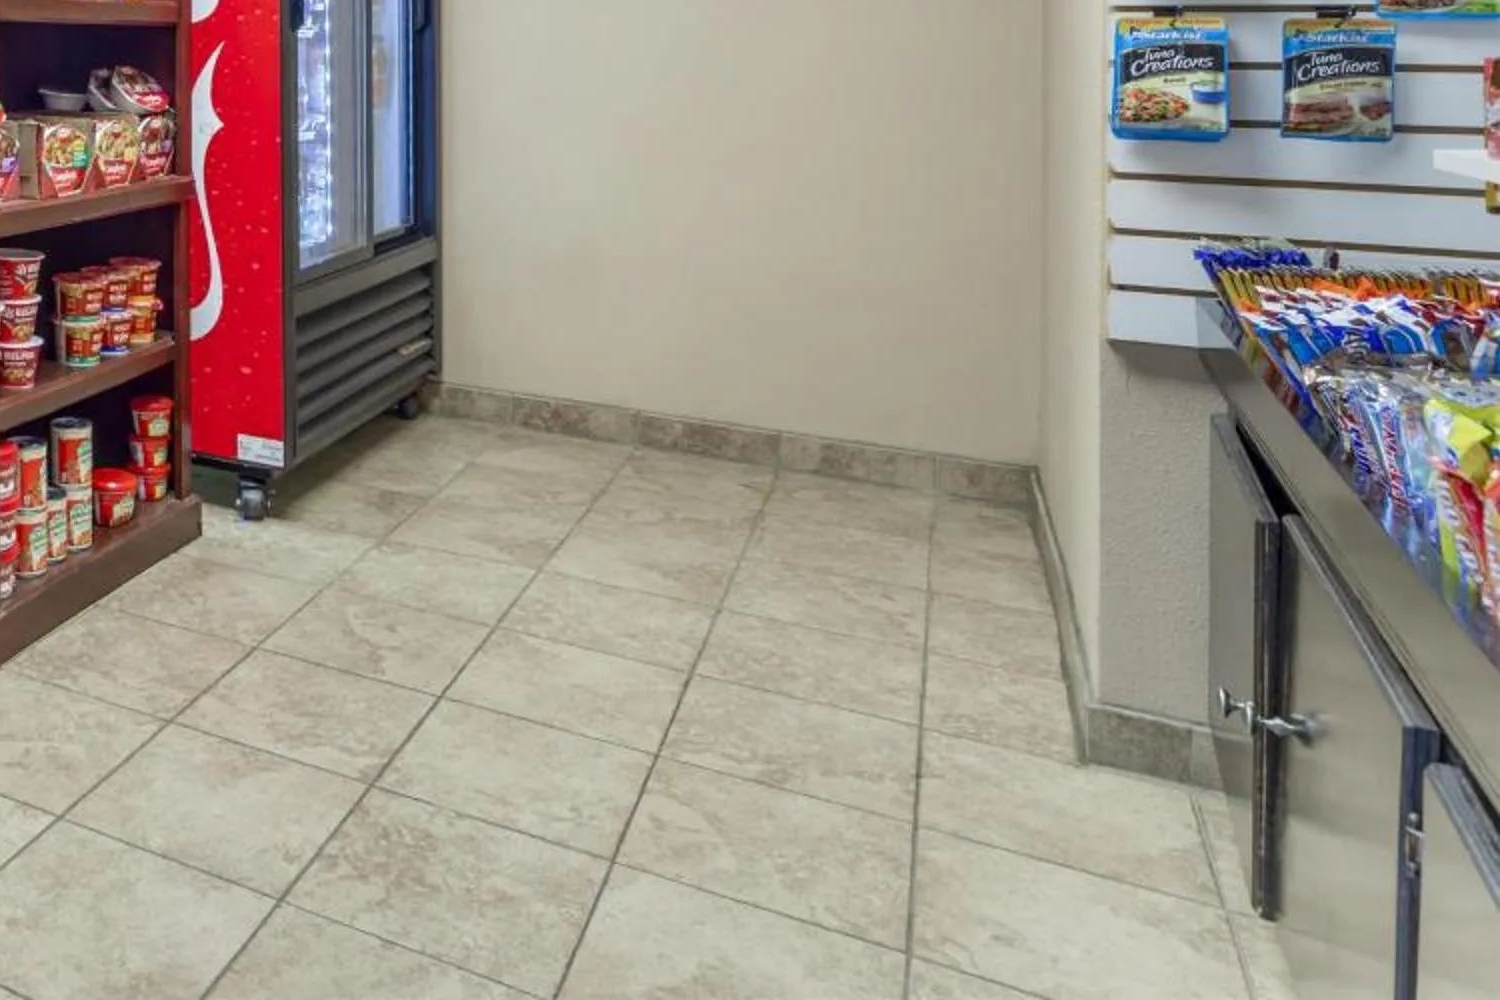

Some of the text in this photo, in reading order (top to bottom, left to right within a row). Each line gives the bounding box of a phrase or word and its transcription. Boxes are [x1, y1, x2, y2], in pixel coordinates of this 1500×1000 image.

[1137, 47, 1175, 62] Tuna
[1303, 51, 1343, 66] Tuna
[1130, 55, 1215, 77] Creations
[1296, 60, 1380, 81] Creations
